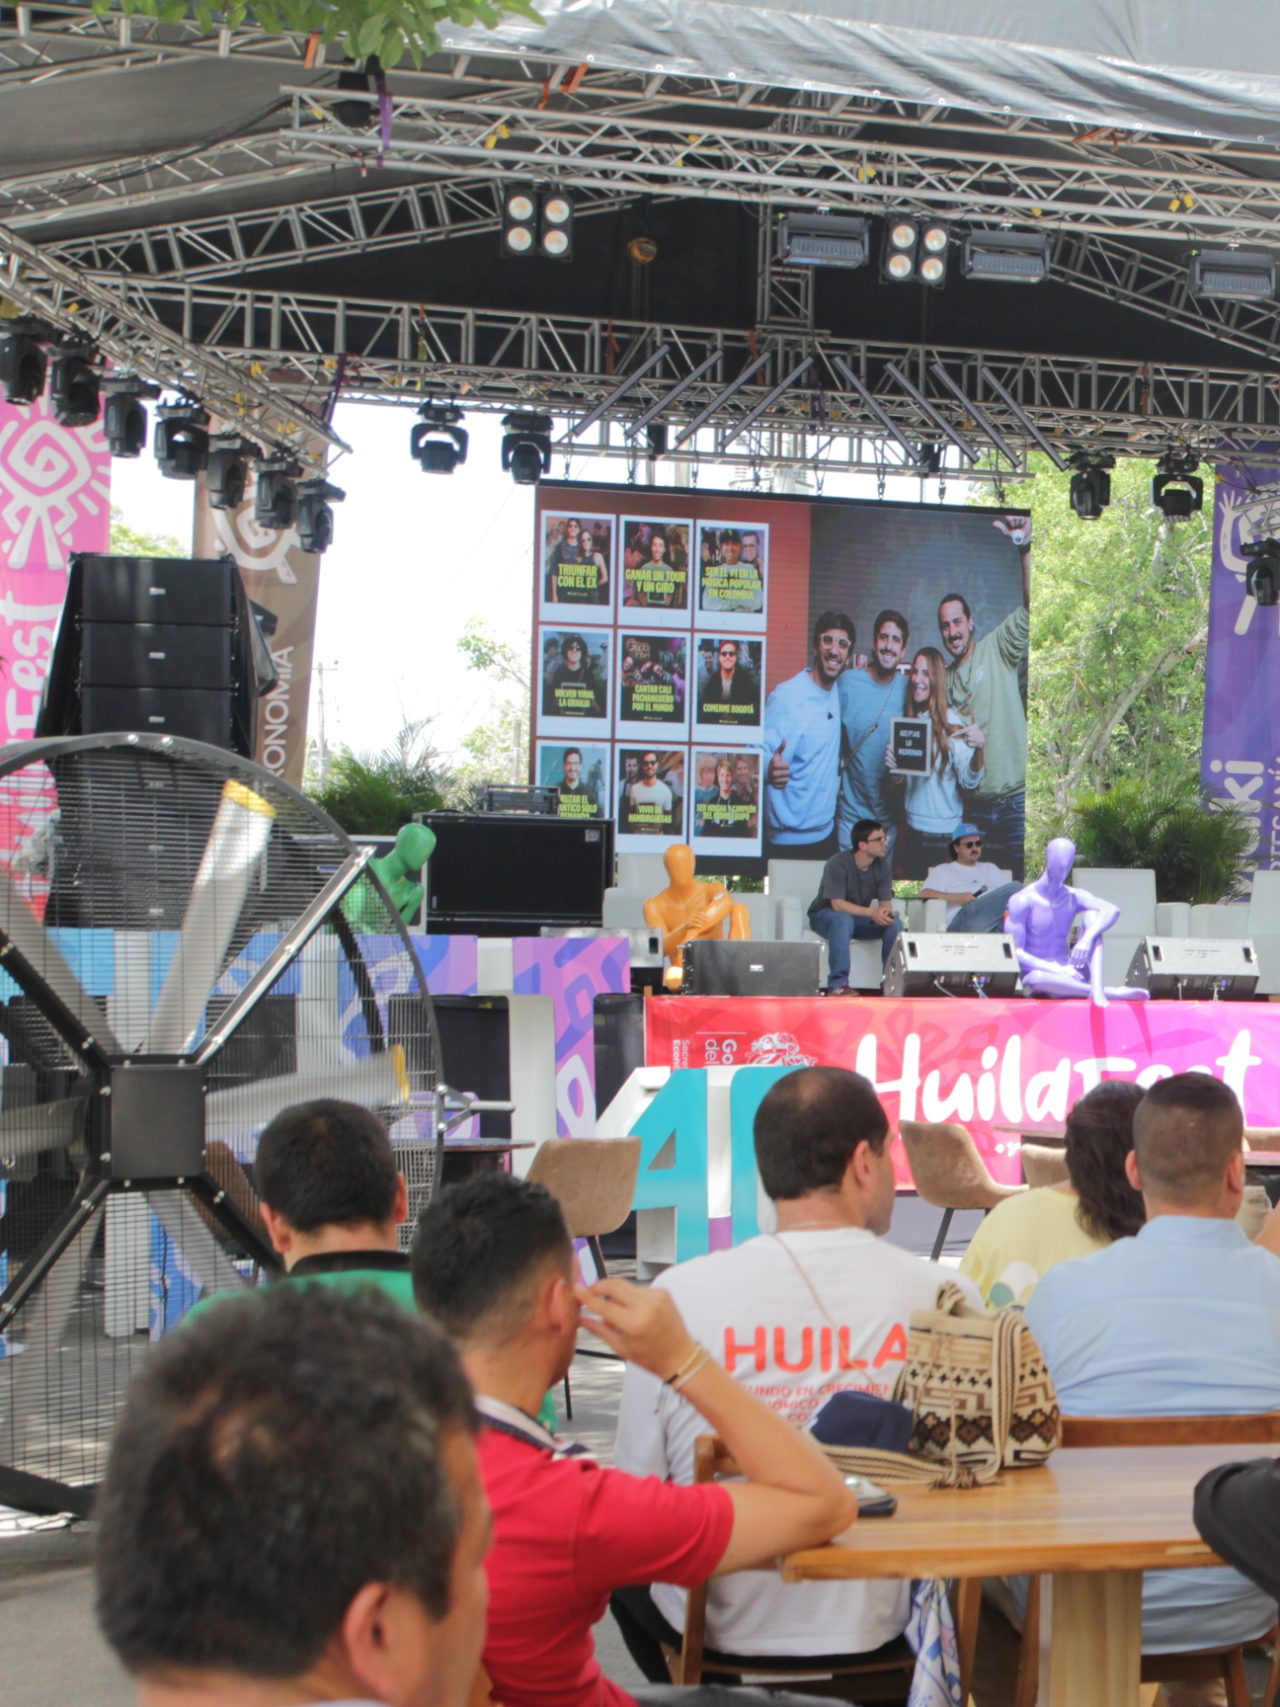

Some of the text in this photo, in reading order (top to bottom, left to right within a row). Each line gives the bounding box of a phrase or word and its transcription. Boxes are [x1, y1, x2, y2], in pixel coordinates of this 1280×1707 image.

[558, 564, 597, 576] TRIUNFAR
[625, 569, 686, 583] GANAR UN TOUR
[558, 576, 597, 588] CON EL EX
[637, 581, 675, 593] Y UN GIRO
[729, 579, 762, 590] POPULAR
[709, 588, 754, 600] EN COLOMBIA
[635, 684, 672, 694] CANTAR CALI
[559, 698, 566, 707] LA
[632, 693, 674, 703] PACHANGUERO
[632, 702, 674, 713] POR EL MUNDO
[703, 703, 754, 714] COMERME BOGOTÁ
[582, 804, 598, 813] SOLO
[724, 1323, 909, 1373] HUILA
[796, 1385, 814, 1396] EN
